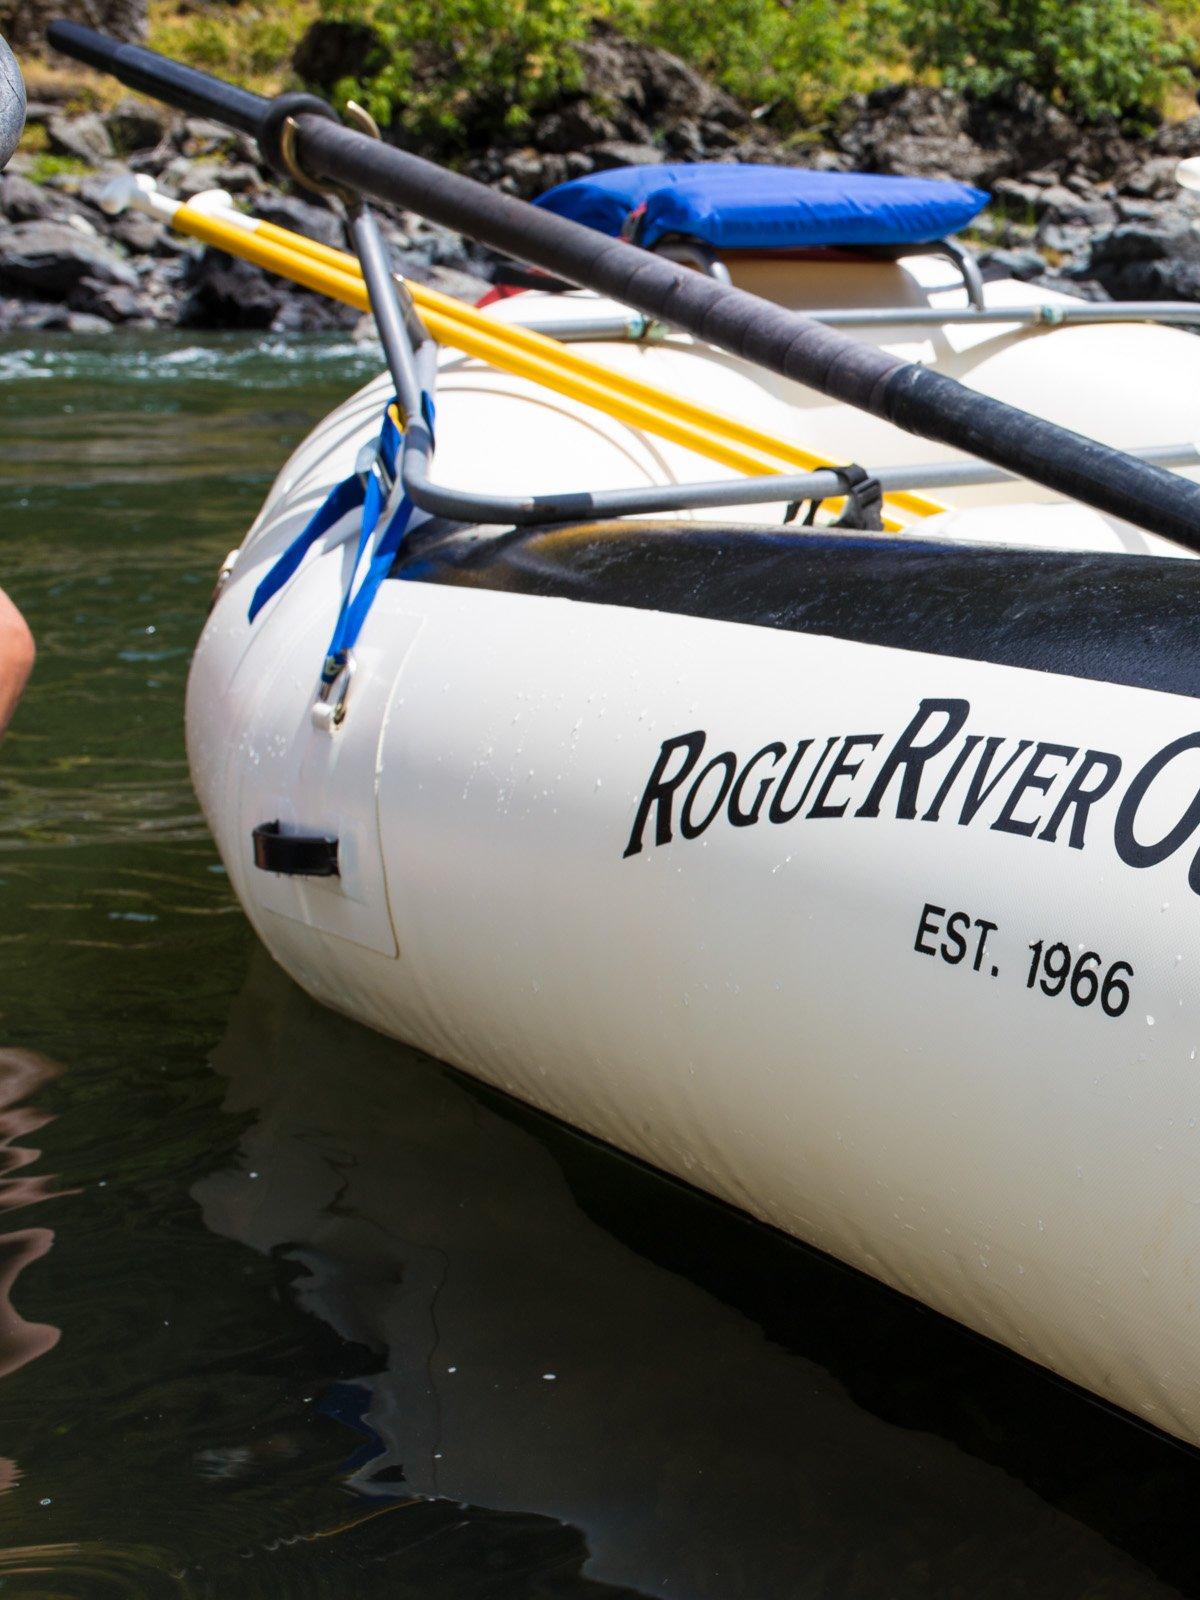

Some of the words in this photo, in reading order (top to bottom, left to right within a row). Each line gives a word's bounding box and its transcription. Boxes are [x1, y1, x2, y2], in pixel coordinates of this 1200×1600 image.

[623, 731, 883, 859] ROGUE
[854, 699, 1122, 850] RIVER
[914, 903, 999, 977] EST.
[1027, 940, 1134, 1017] 1966
